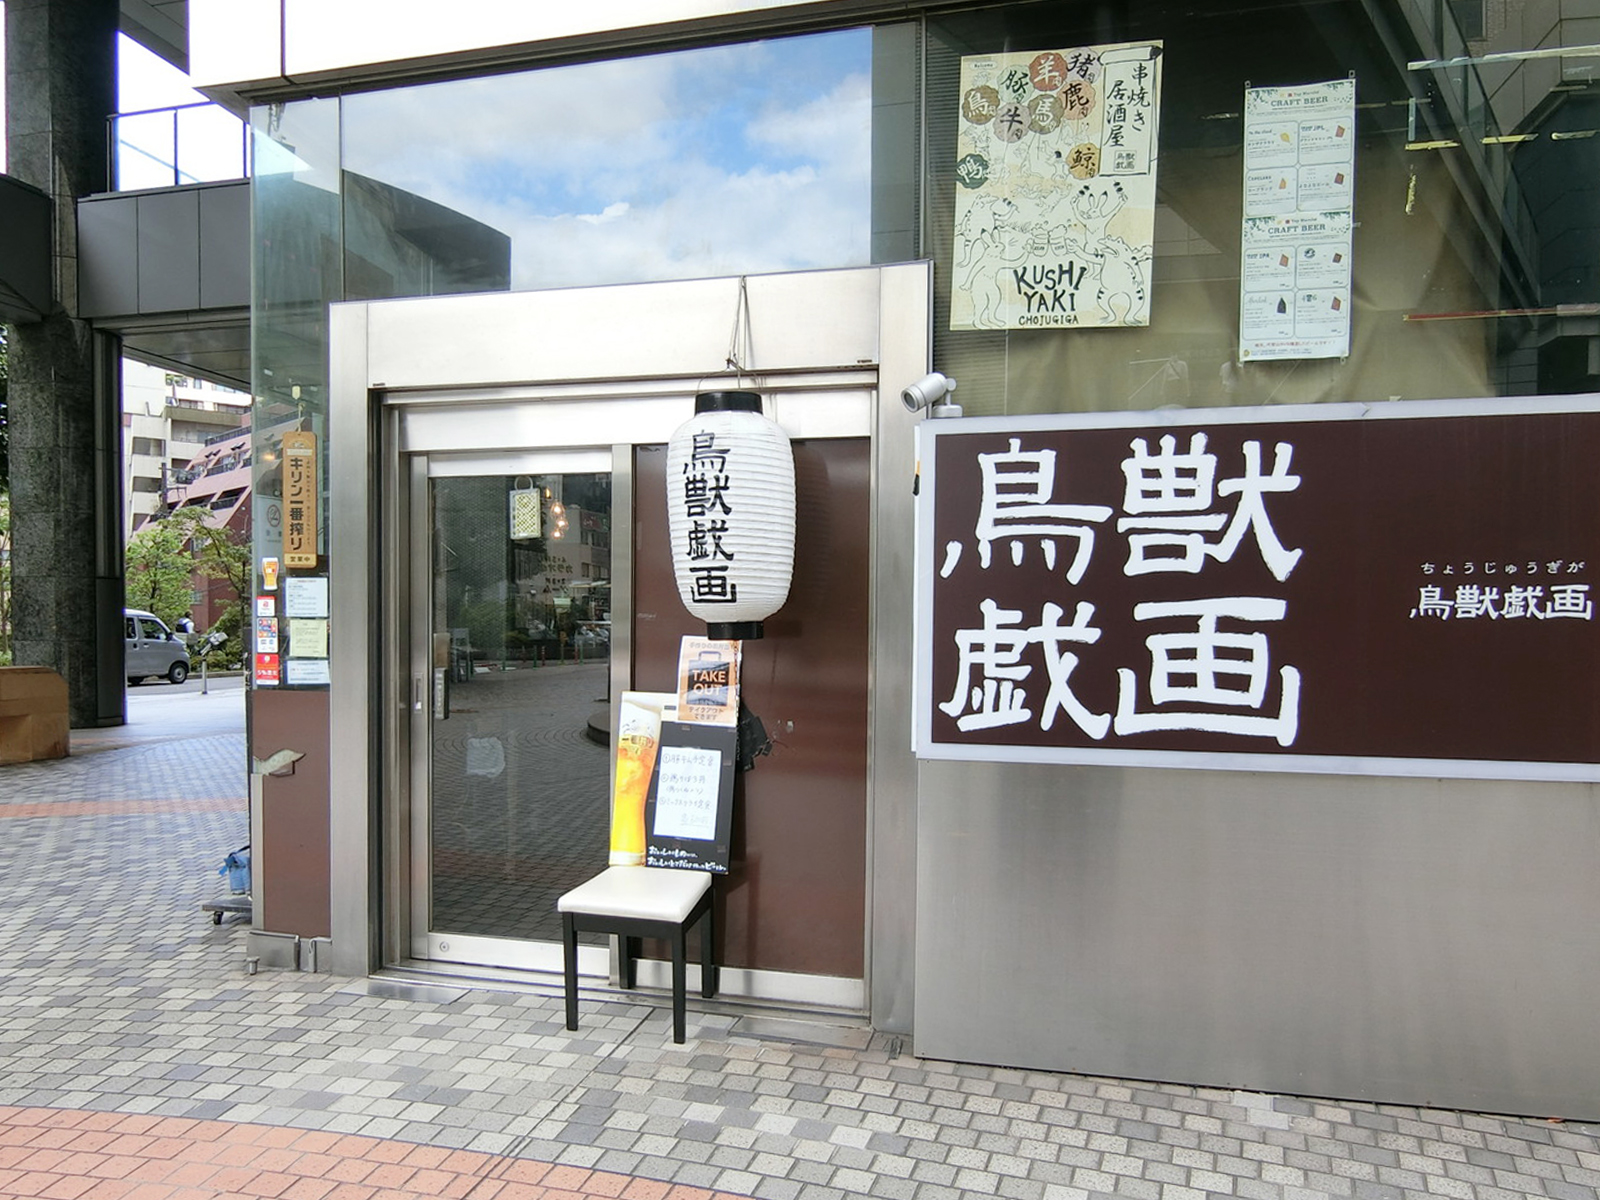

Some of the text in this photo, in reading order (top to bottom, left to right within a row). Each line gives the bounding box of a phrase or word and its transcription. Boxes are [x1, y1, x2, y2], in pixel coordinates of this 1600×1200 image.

[1127, 62, 1151, 132] 串焼き
[1270, 98, 1301, 108] CRAFT
[1303, 95, 1329, 105] BEER
[1103, 79, 1127, 148] 居酒屋
[1267, 225, 1299, 235] CRAFT
[1301, 223, 1327, 232] BEER
[1013, 260, 1088, 295] KUSHI
[1024, 289, 1076, 313] YAKI
[1018, 315, 1080, 326] CHOJUGIGA
[289, 457, 305, 551] キリン一番搾り
[682, 428, 738, 604] 鳥獣戯画
[938, 431, 1303, 586] 鳥獣
[1420, 559, 1586, 575] ちょうじゅうぎが
[1408, 583, 1593, 621] 鳥獣戯画
[691, 669, 727, 683] TAKE
[937, 596, 1302, 747] 戯画
[693, 683, 723, 696] OUT
[688, 706, 724, 714] テイクアウト
[694, 713, 718, 721] できます
